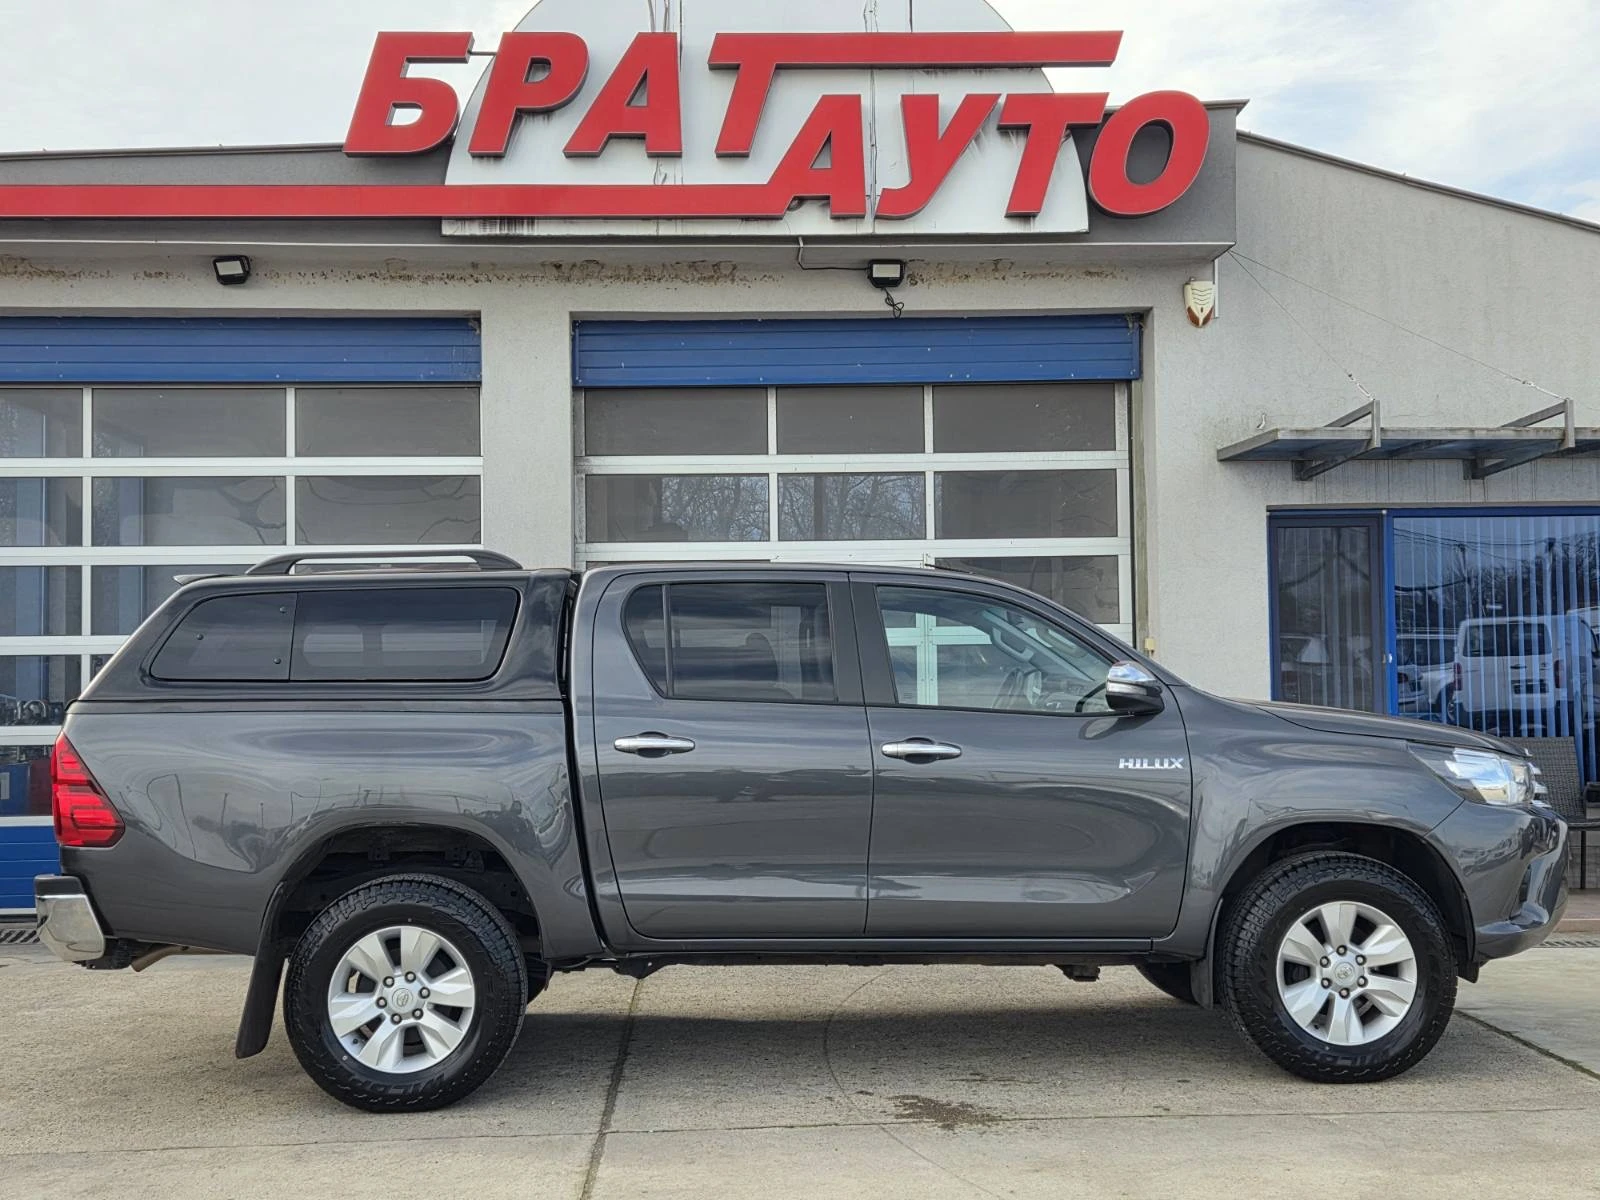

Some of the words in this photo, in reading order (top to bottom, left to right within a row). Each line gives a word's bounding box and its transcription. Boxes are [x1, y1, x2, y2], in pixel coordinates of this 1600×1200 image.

[344, 31, 1123, 157] БРАТ
[768, 90, 1210, 219] АУТО
[1118, 757, 1184, 769] HILUX
